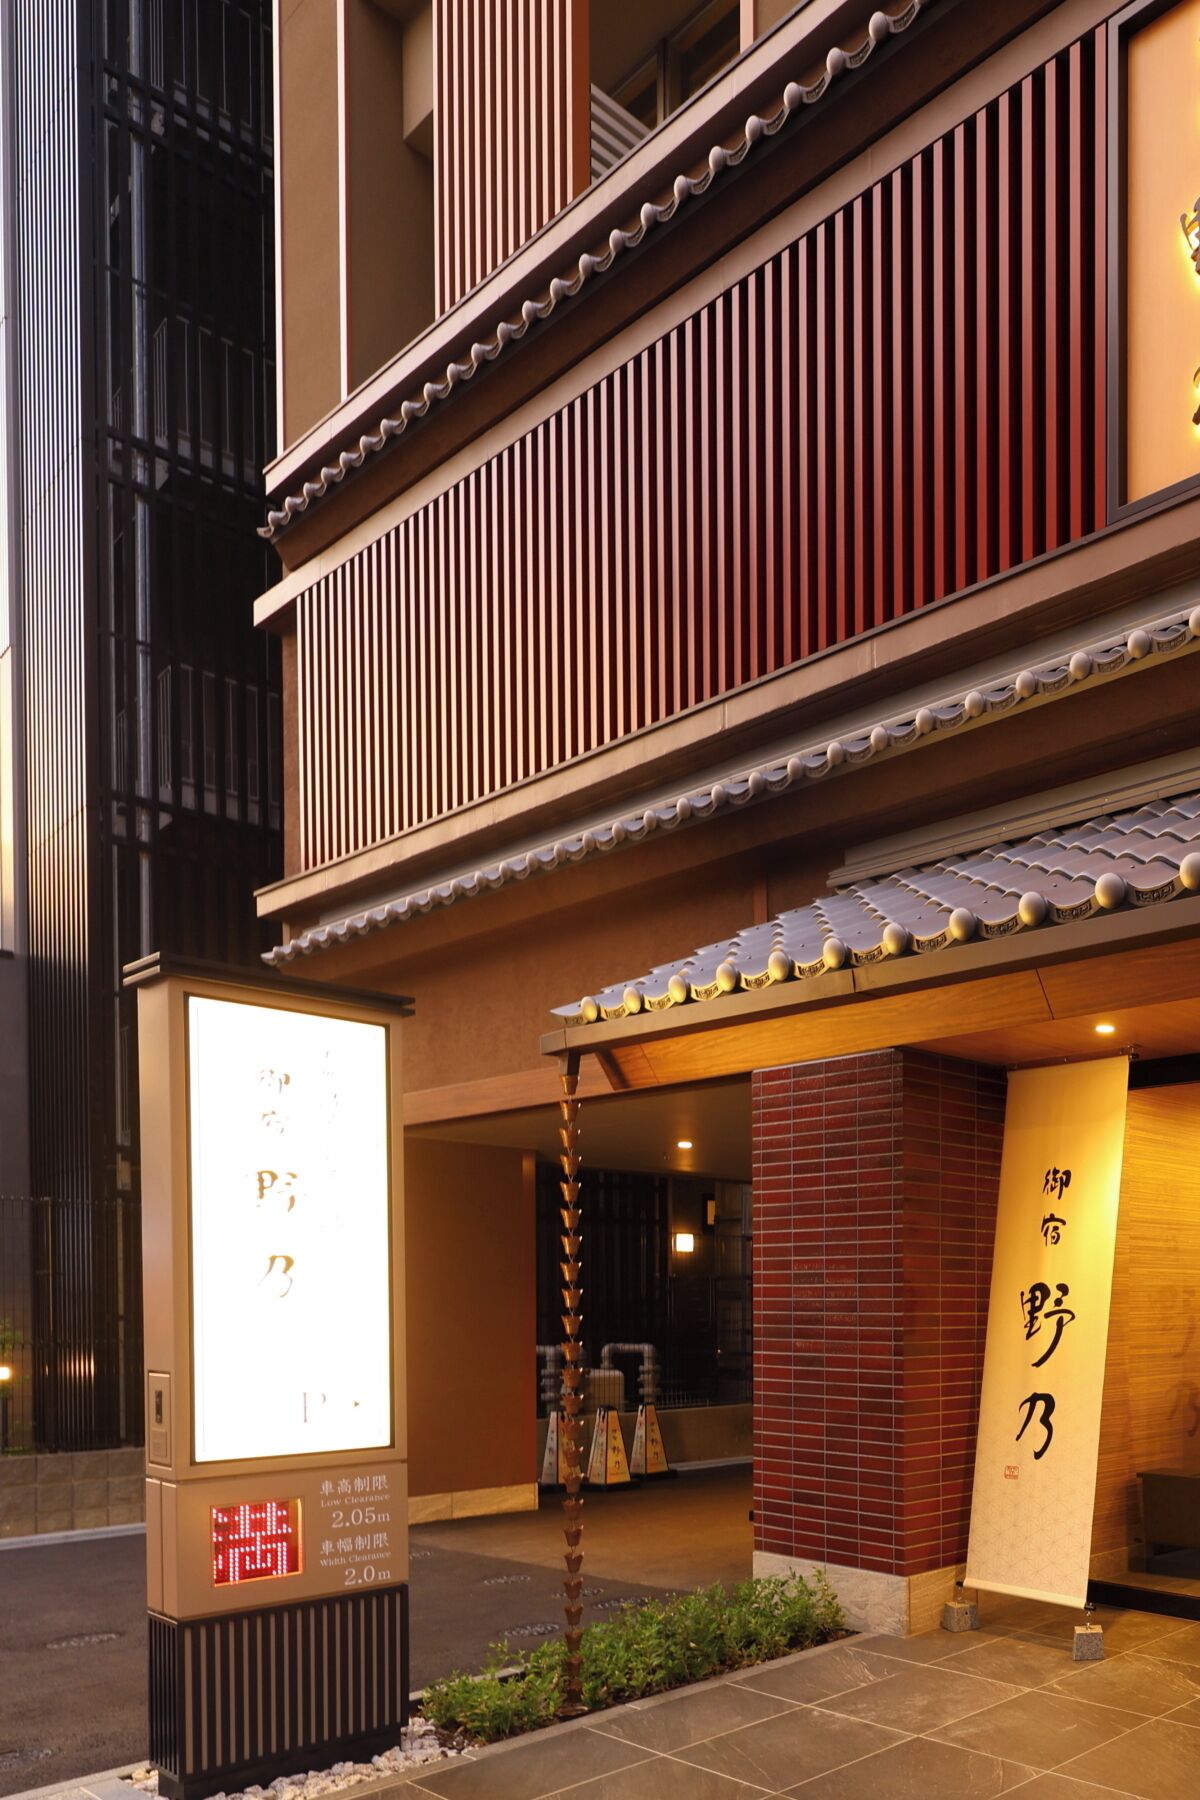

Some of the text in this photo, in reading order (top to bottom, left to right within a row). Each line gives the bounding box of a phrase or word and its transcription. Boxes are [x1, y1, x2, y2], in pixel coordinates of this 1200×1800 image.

[1015, 1167, 1076, 1461] 御宿野乃
[320, 1474, 389, 1497] 車高制限
[321, 1493, 391, 1508] Low Clearance
[320, 1532, 389, 1556] 車幅制限
[320, 1550, 392, 1567] Width Clearance
